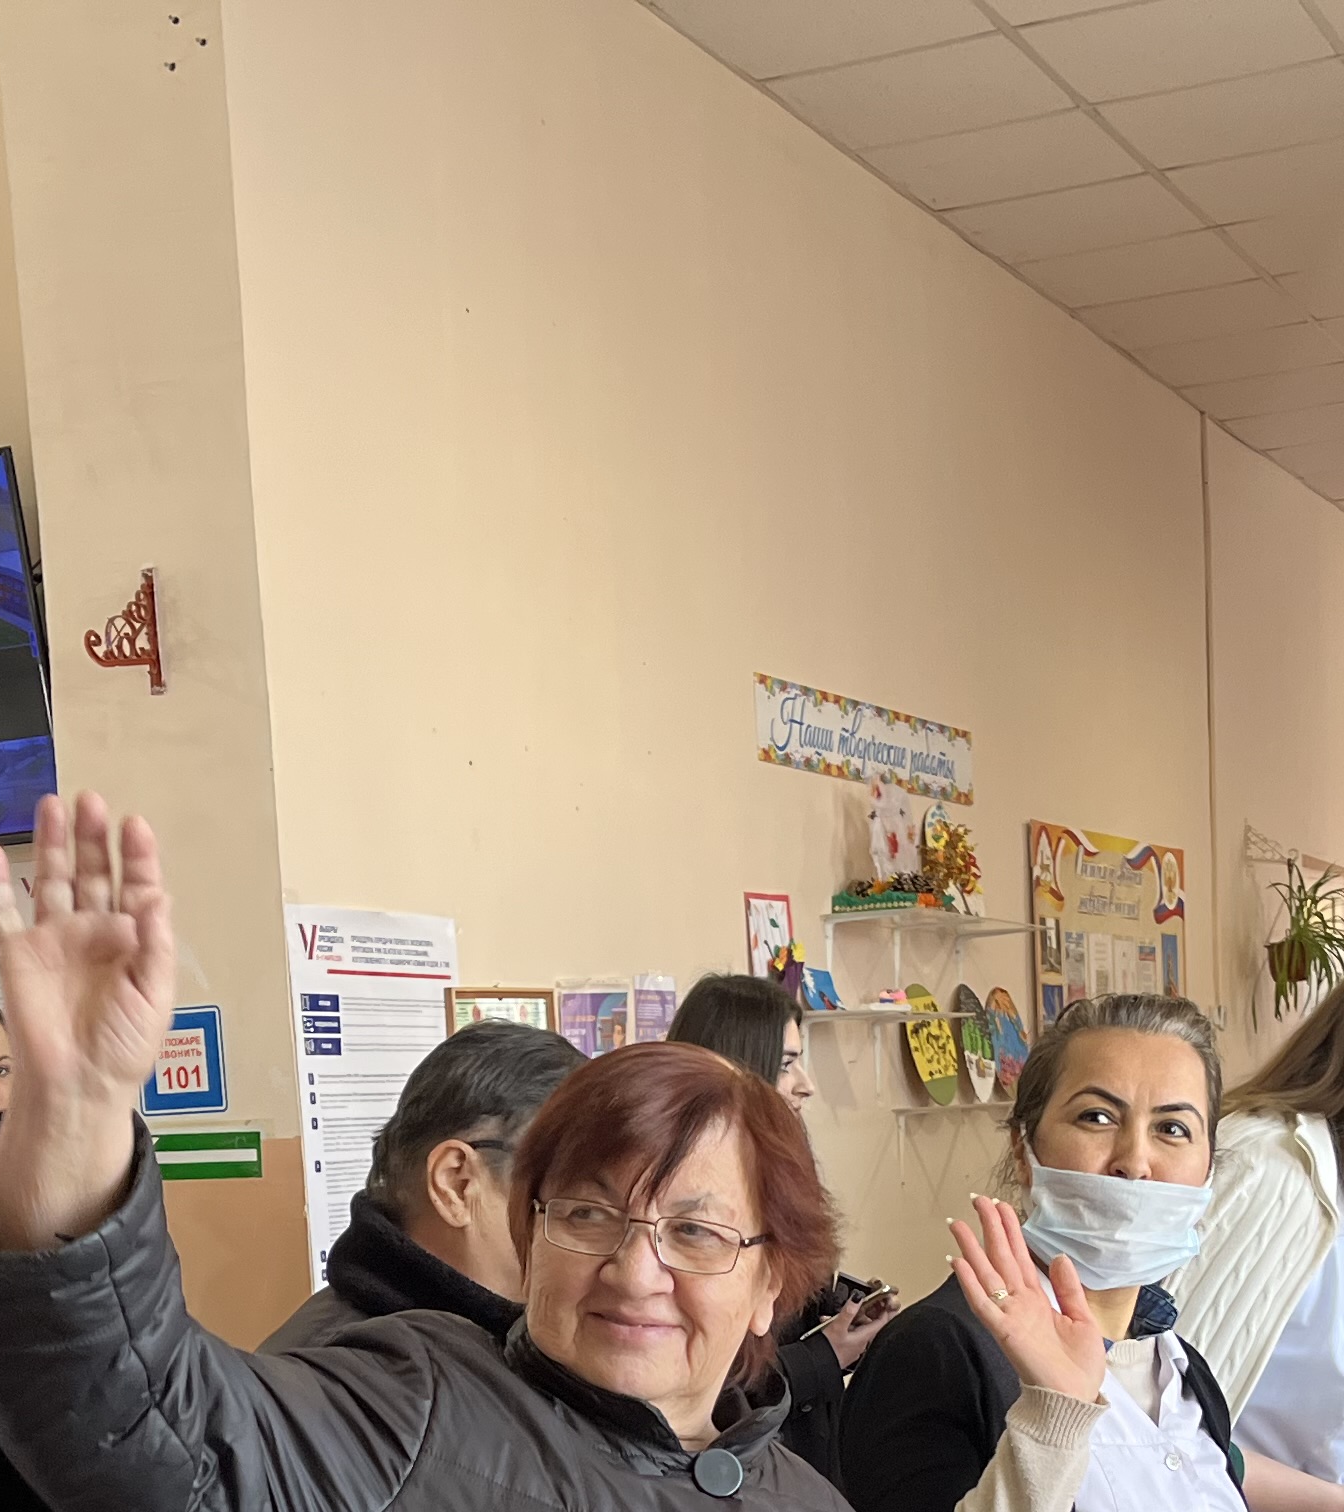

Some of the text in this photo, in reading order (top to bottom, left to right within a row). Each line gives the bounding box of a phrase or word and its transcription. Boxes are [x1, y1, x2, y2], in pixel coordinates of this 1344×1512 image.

[164, 1035, 201, 1047] ПОЖАРЕ
[158, 1048, 203, 1060] ЗВОНИТЬ
[162, 1064, 202, 1090] 101
